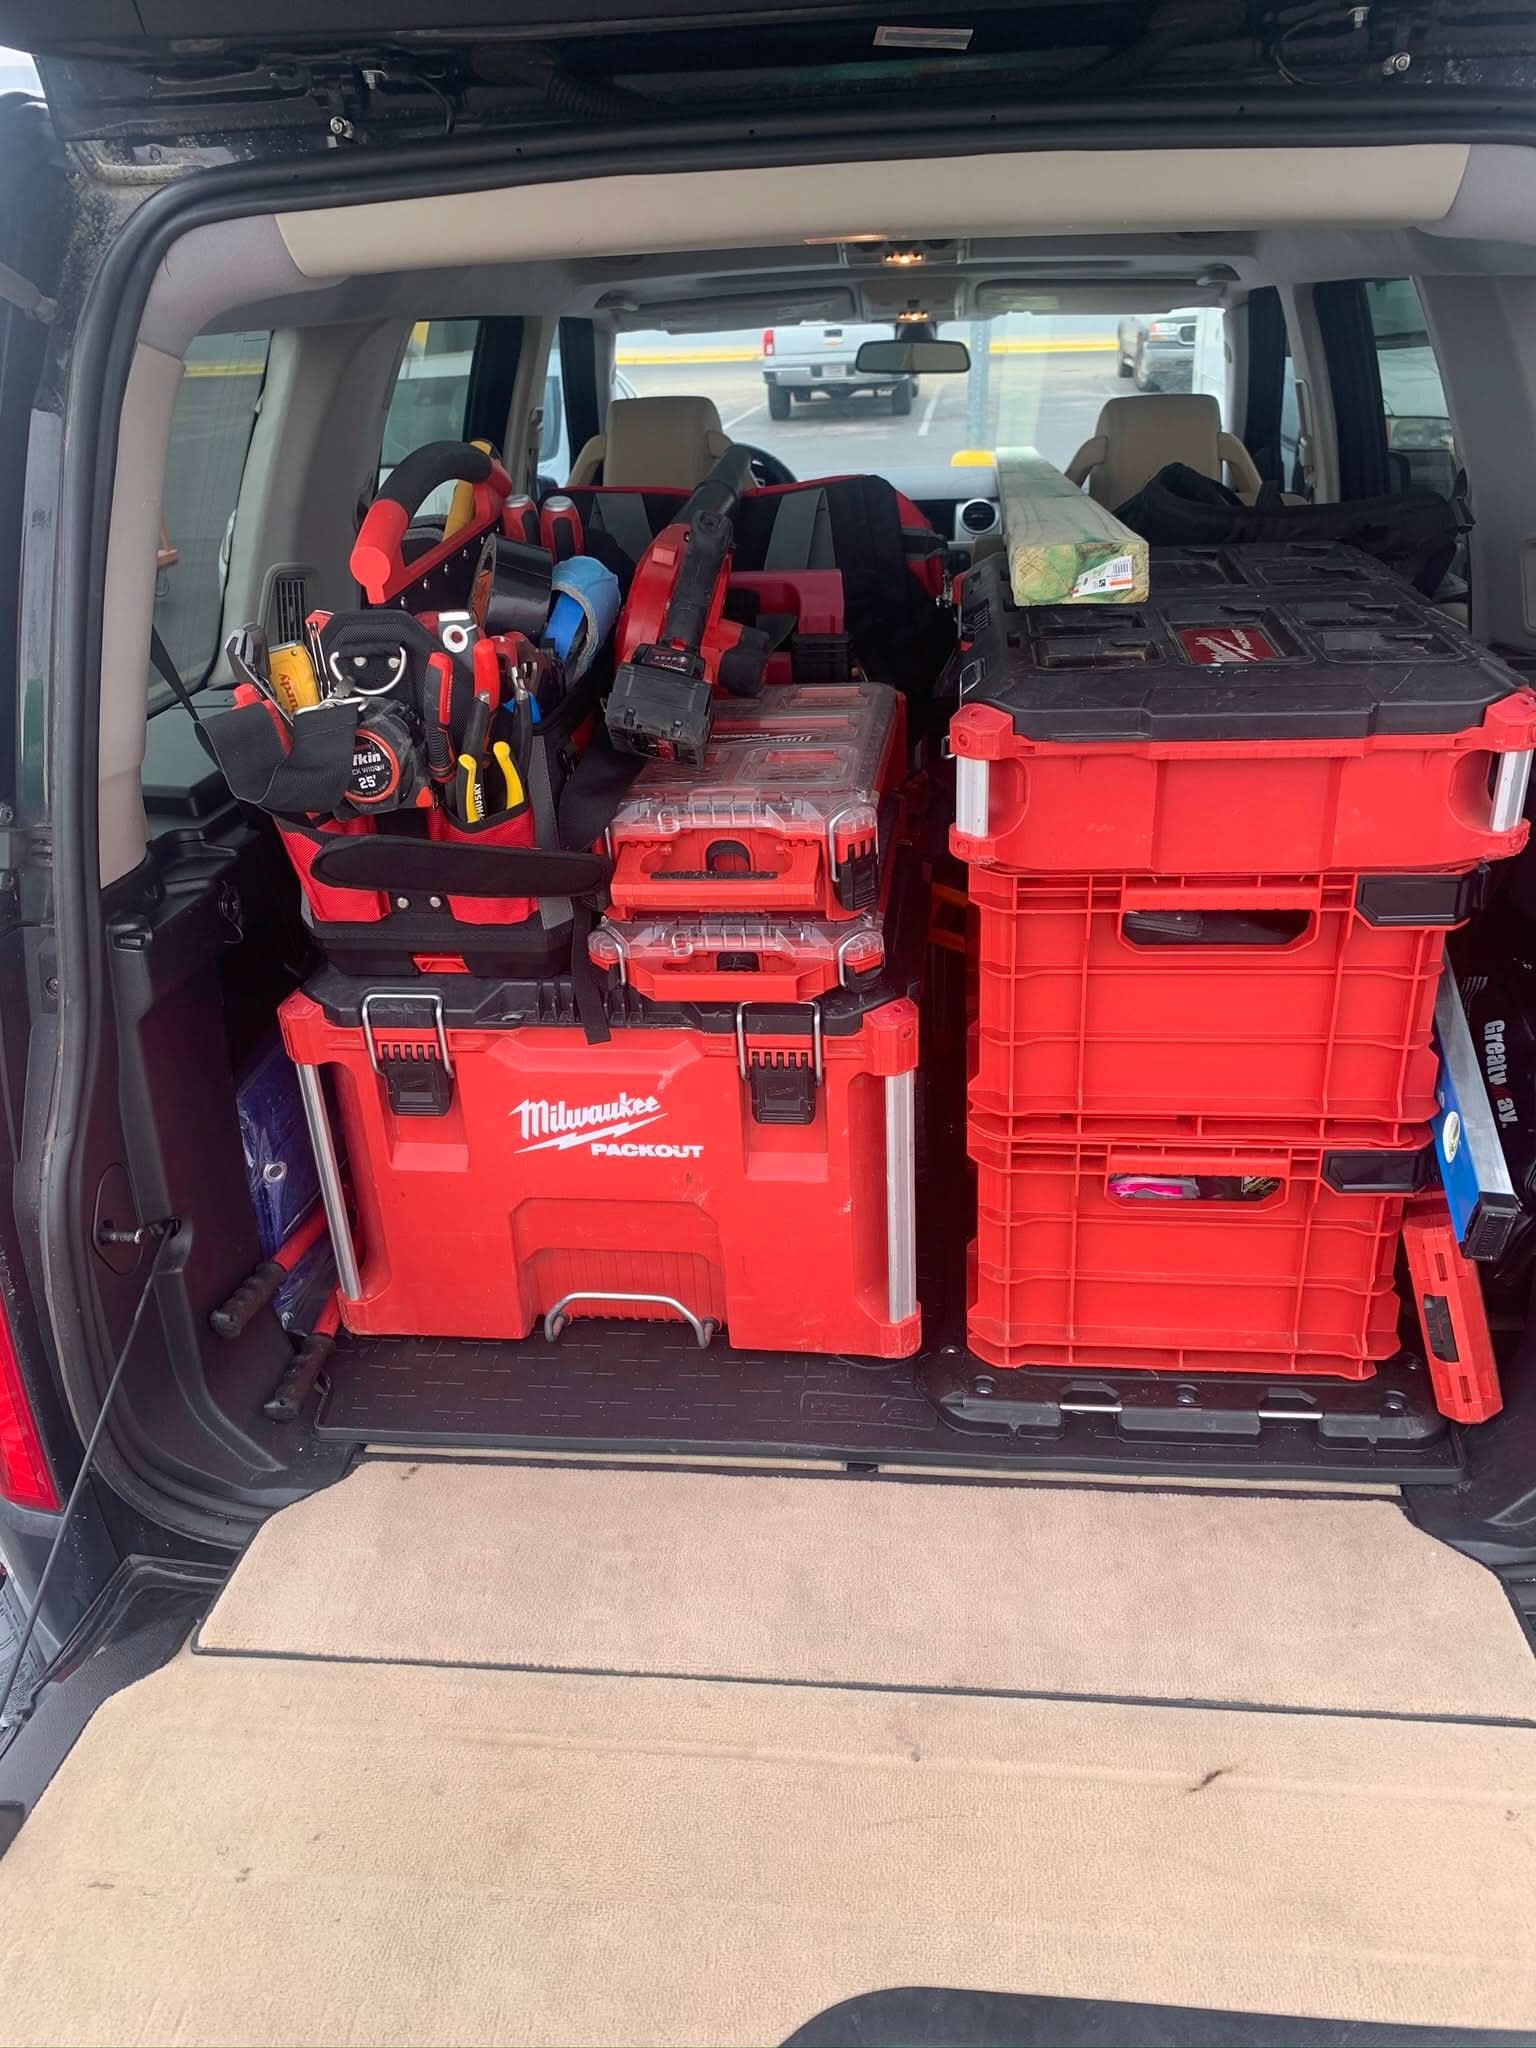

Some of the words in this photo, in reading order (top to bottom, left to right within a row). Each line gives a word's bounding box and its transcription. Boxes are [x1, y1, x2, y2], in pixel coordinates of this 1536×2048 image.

[279, 673, 299, 711] urdy
[474, 783, 485, 814] HUSKY
[508, 1092, 661, 1141] Milwaukee
[591, 1143, 704, 1159] PACKOUT
